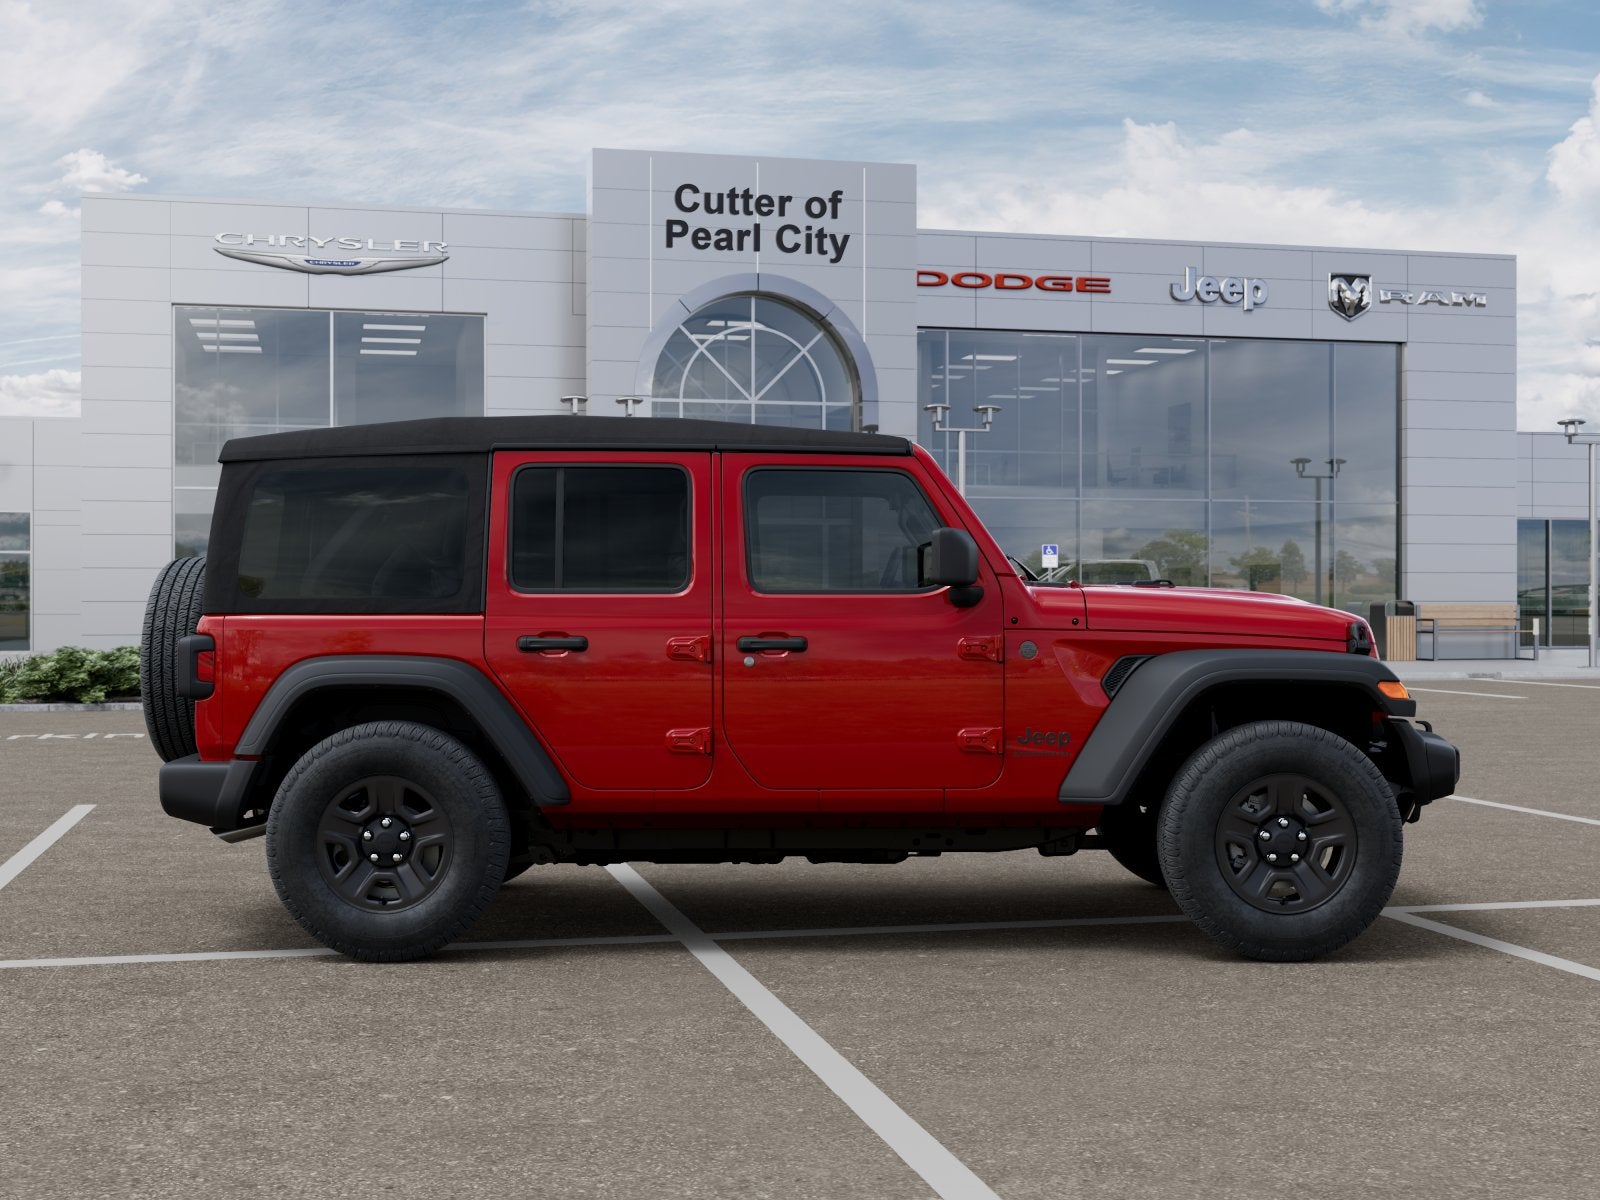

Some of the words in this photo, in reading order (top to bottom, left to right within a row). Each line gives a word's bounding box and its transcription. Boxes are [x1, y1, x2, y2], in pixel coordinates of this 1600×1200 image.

[674, 183, 793, 217] Cutter
[804, 190, 844, 219] of
[215, 232, 449, 253] CHRYSLER
[665, 219, 761, 252] Pearl
[775, 223, 851, 264] City
[916, 270, 1111, 294] DODGE
[1169, 266, 1269, 312] Jeep
[1379, 289, 1487, 308] RAM
[0, 732, 145, 740] rkin
[1017, 726, 1071, 749] Jeep
